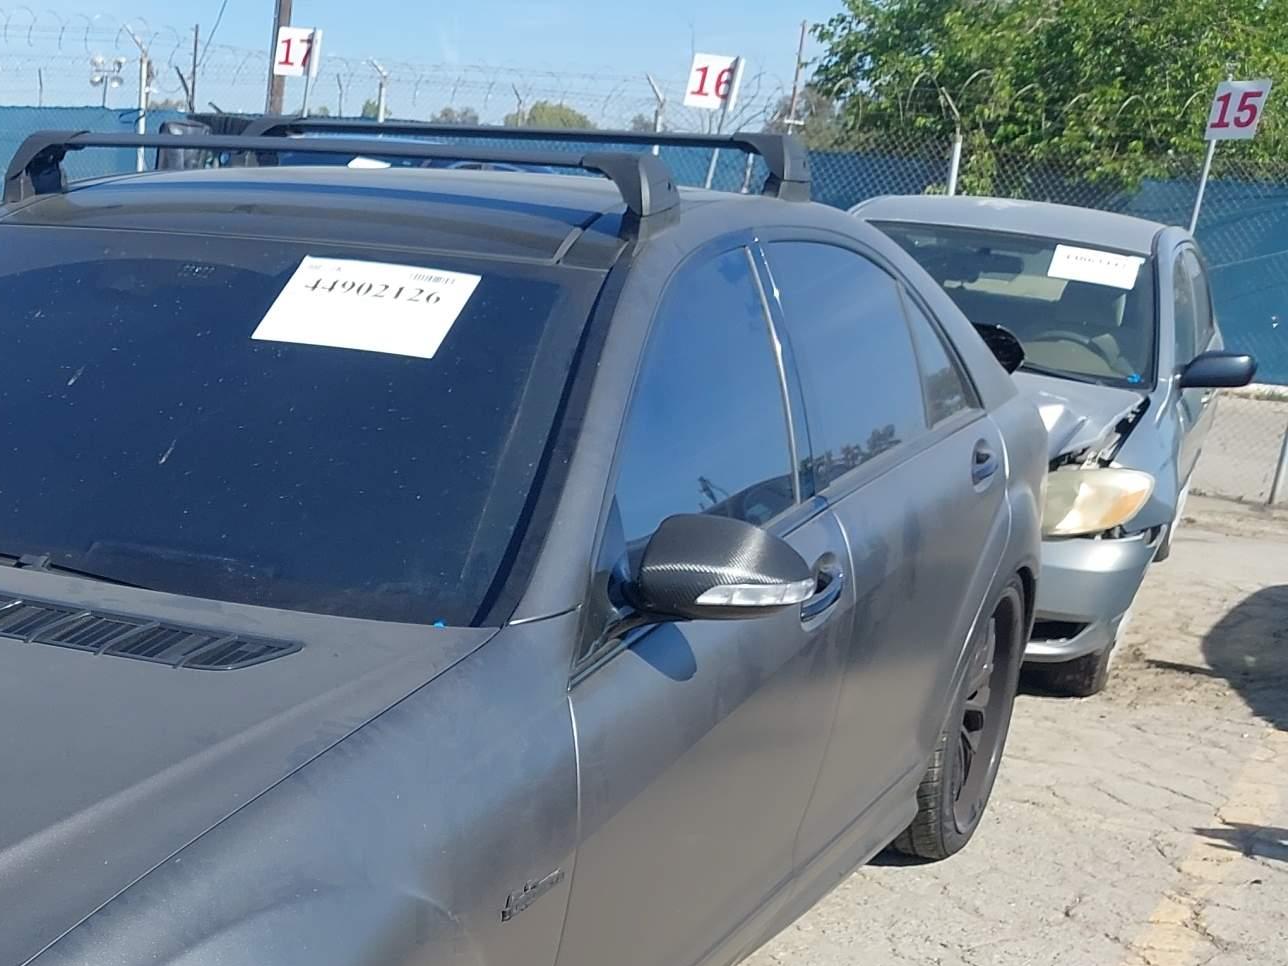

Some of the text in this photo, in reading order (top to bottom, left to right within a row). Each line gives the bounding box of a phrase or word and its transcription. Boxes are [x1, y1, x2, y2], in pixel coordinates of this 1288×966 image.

[278, 38, 313, 67] 17
[690, 65, 735, 99] 16
[1210, 91, 1263, 128] 15
[304, 277, 441, 305] 44902126
